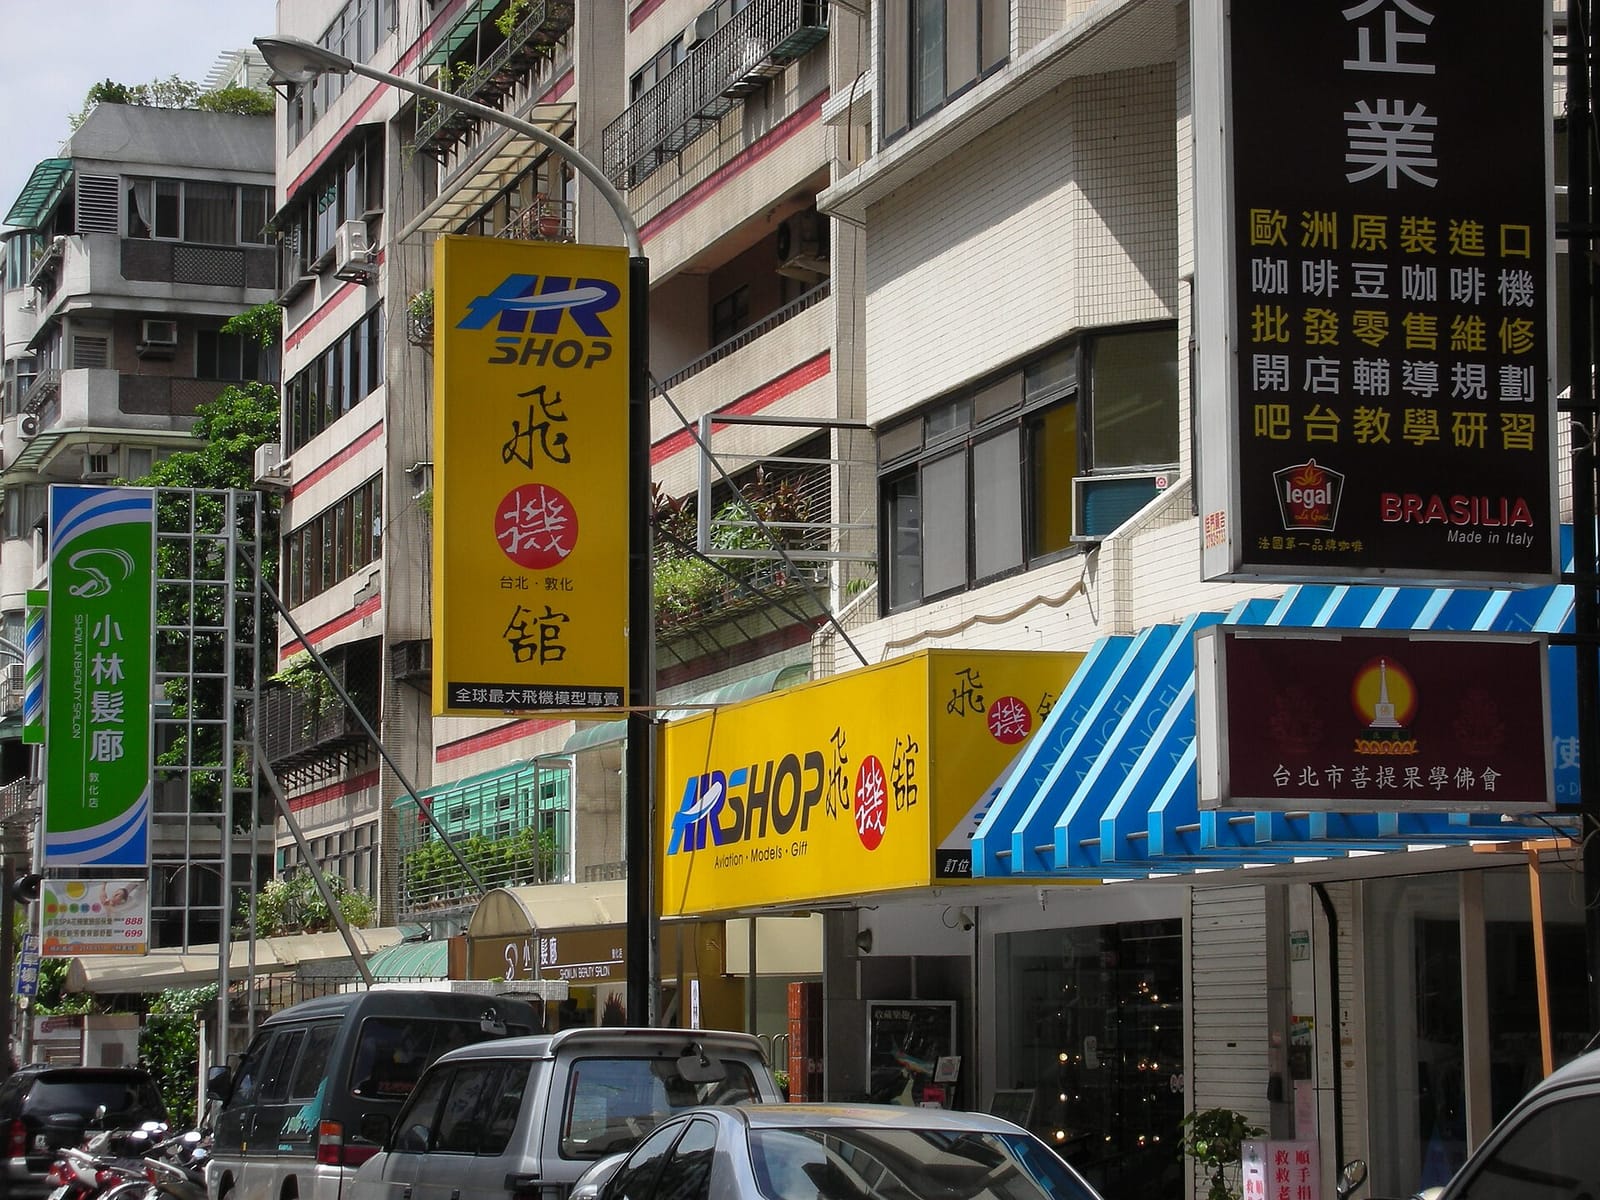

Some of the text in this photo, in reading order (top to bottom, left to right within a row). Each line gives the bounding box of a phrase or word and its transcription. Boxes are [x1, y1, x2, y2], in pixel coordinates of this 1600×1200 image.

[1249, 208, 1531, 259] 歐洲原裝進口
[1251, 257, 1535, 308] 咖啡豆咖啡機
[455, 273, 621, 338] AIR
[1251, 304, 1536, 355] 批發零售維修
[487, 336, 612, 369] SHOP
[1252, 354, 1537, 403] 開店輔導規劃
[1254, 404, 1536, 451] 吧台教學研習
[1286, 480, 1331, 508] legal
[1380, 492, 1534, 527] BRASILIA
[1447, 530, 1534, 548] Made in Italy
[90, 613, 126, 763] 小林髮廊
[455, 687, 619, 707] 全球最大飛機模型專賣
[1272, 764, 1502, 793] 台北市菩提果學佛會
[714, 841, 808, 869] Aviation Models Gift
[124, 917, 143, 926] 888
[124, 929, 143, 938] 699
